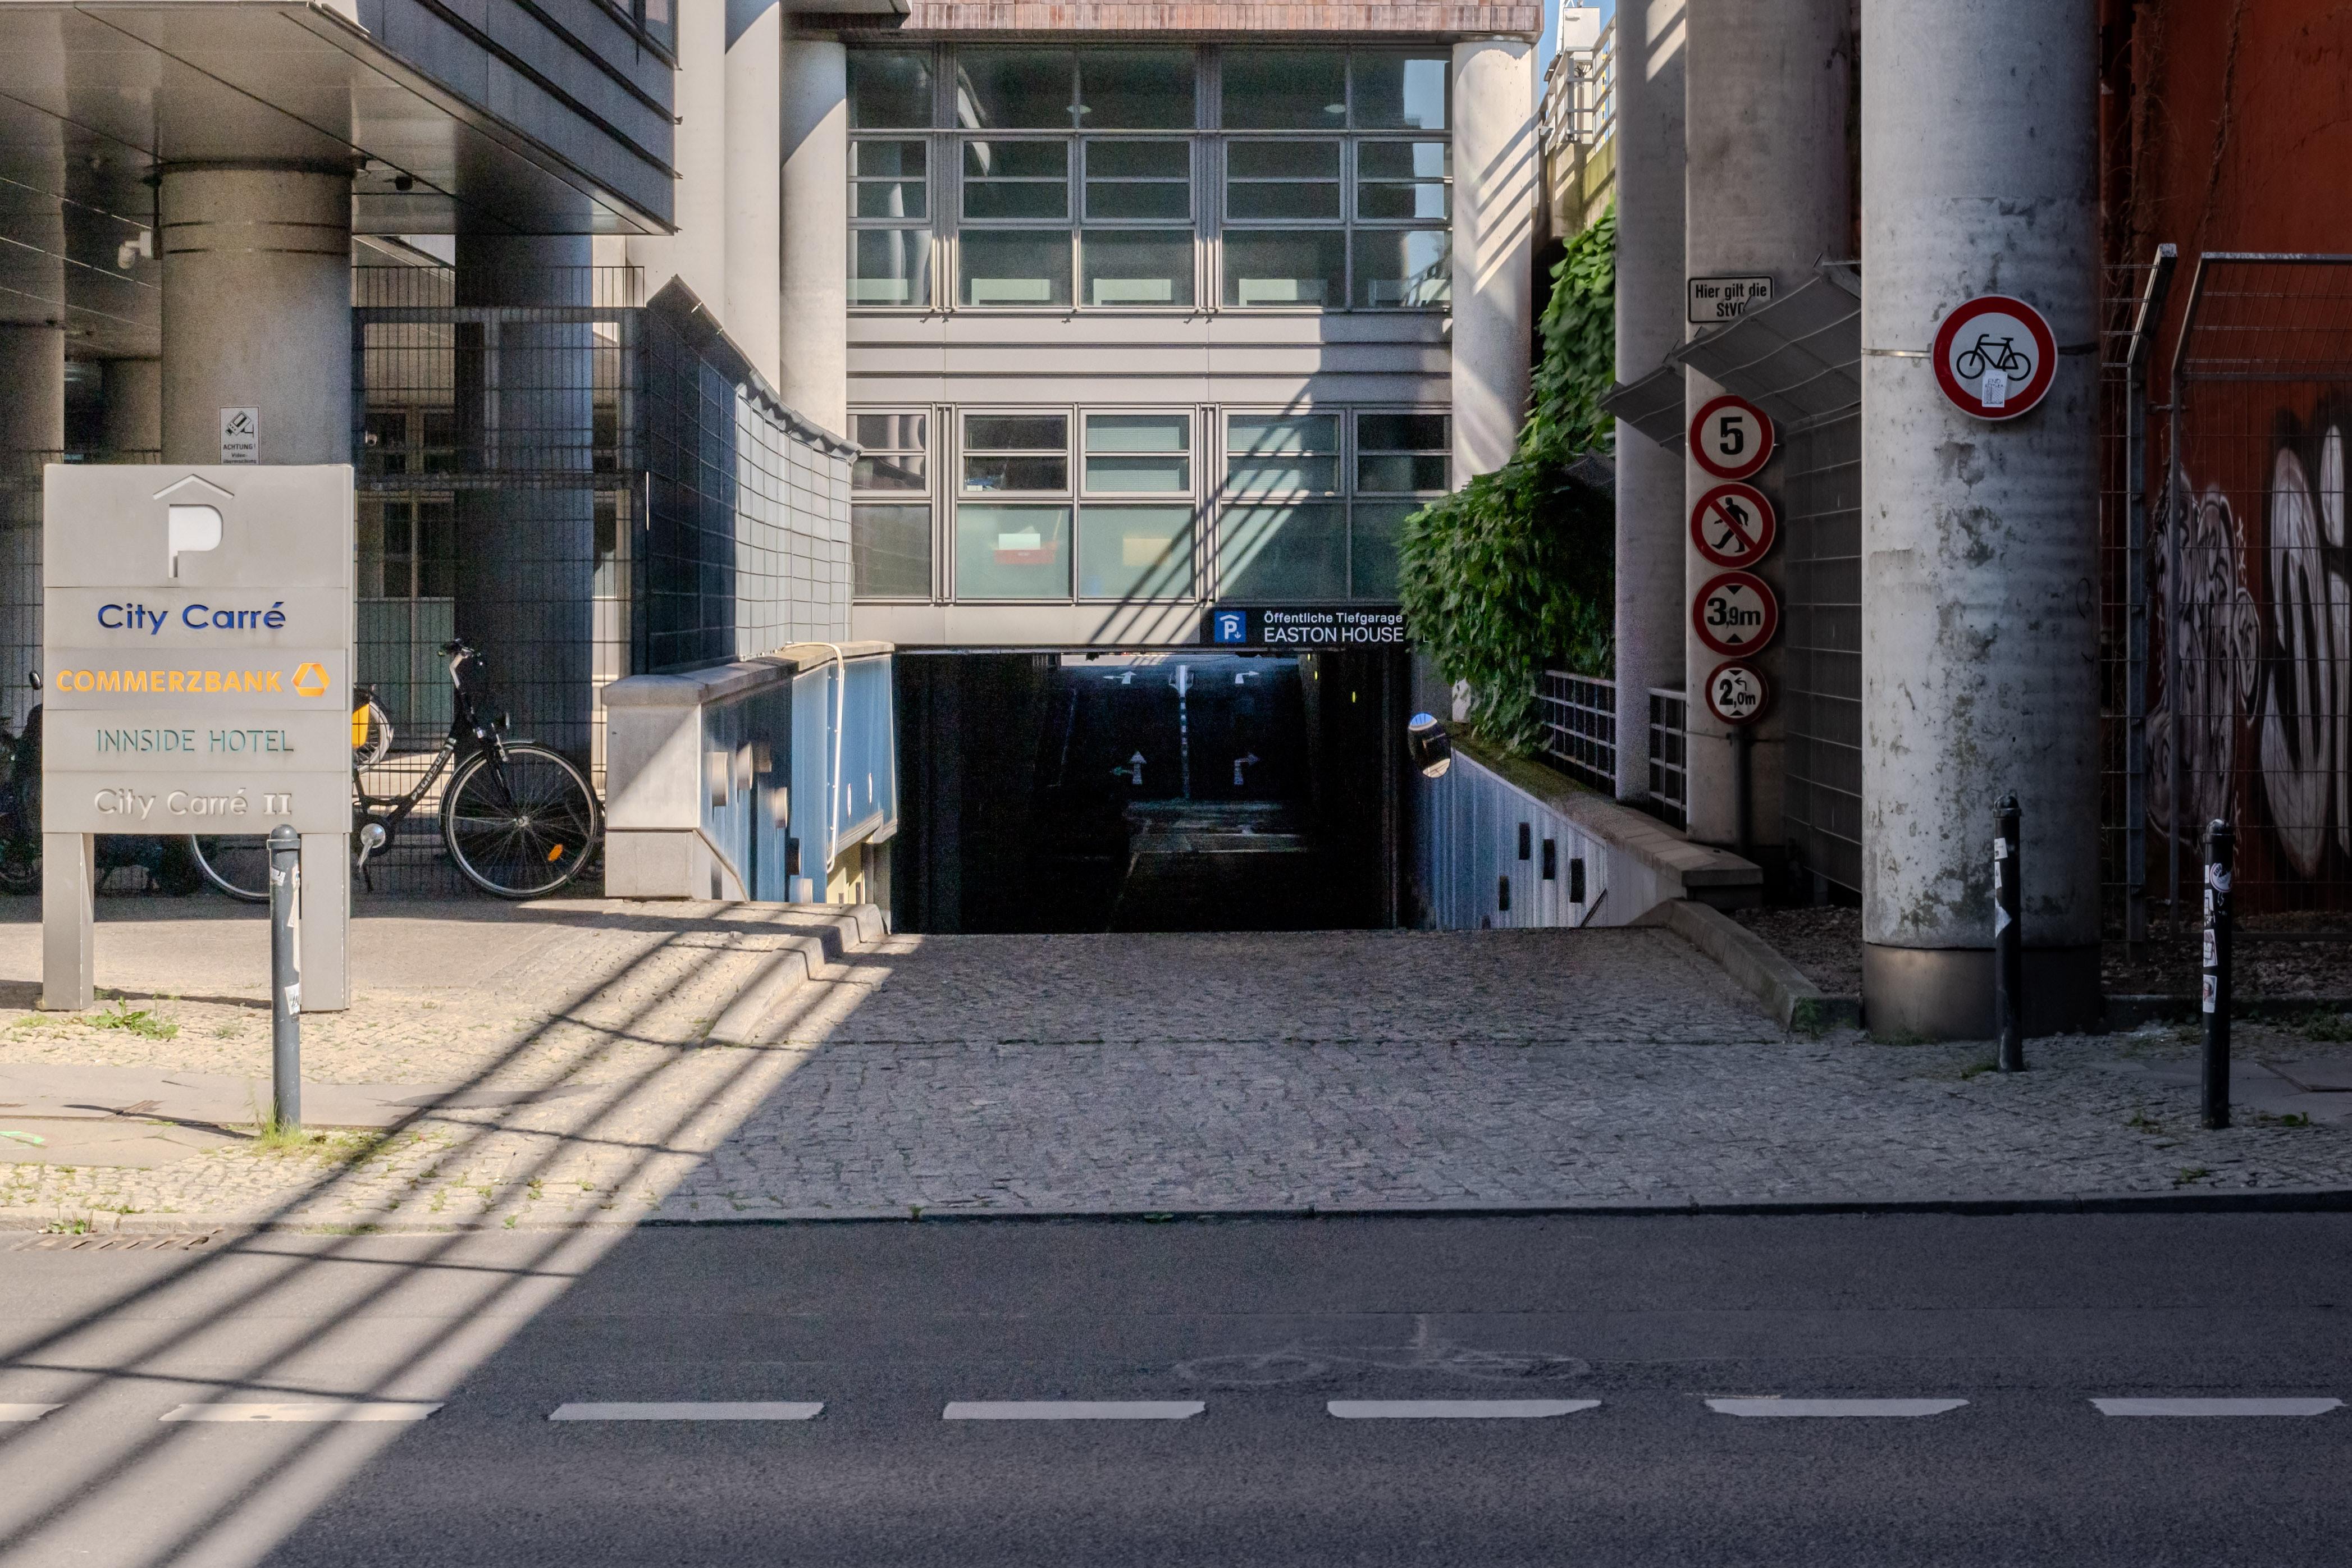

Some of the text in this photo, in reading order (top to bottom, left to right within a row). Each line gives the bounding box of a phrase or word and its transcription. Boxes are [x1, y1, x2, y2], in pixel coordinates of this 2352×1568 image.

[1696, 282, 1767, 301] Hier gilt die
[1720, 417, 1744, 455] 5
[169, 504, 223, 578] P
[97, 601, 286, 635] City Carré
[1264, 610, 1403, 625] Öffentliche Tiefgarage
[1224, 621, 1237, 639] P
[1264, 627, 1404, 642] EASTON HOUSE
[56, 669, 283, 692] COMMERZBANK
[97, 729, 294, 752] INNSIDE HOTEL
[94, 787, 293, 820] City Carré II
